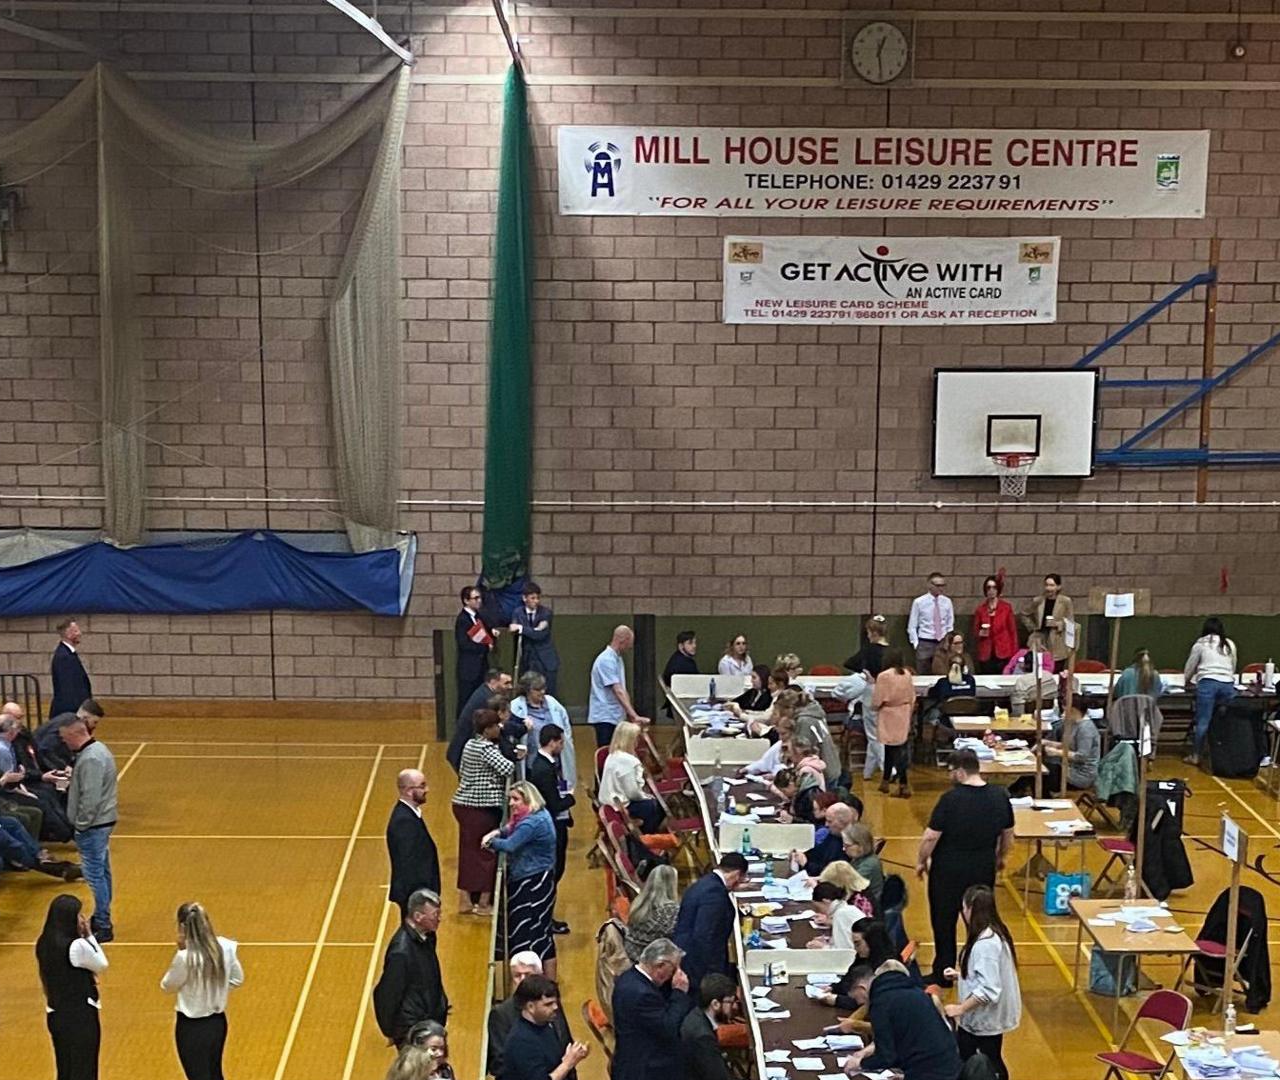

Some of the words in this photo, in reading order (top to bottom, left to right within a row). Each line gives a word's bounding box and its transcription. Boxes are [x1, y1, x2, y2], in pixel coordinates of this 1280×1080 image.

[635, 135, 710, 164] MILL
[724, 136, 839, 165] HOUSE
[855, 137, 993, 166] LEISURE
[1006, 138, 1139, 167] CENTRE
[744, 173, 874, 190] TELEPHONE:
[881, 174, 942, 190] 01429
[715, 196, 755, 210] ALL
[765, 196, 830, 210] YOUR
[836, 197, 923, 211] LEISURE
[780, 262, 832, 281] GET
[936, 263, 1003, 282] WITH
[906, 287, 922, 299] AN
[925, 287, 966, 299] ACTIVE
[968, 287, 1002, 299] CARD
[754, 299, 783, 308] NEW
[786, 299, 837, 309] LEISURE
[840, 300, 874, 309] CARD
[877, 300, 929, 309] SCHEME
[743, 309, 769, 318] TEL:
[771, 309, 807, 318] 01429
[900, 310, 919, 319] OR
[921, 310, 946, 319] ASK
[949, 310, 965, 318] AT
[967, 309, 1038, 318] RECEPTION
